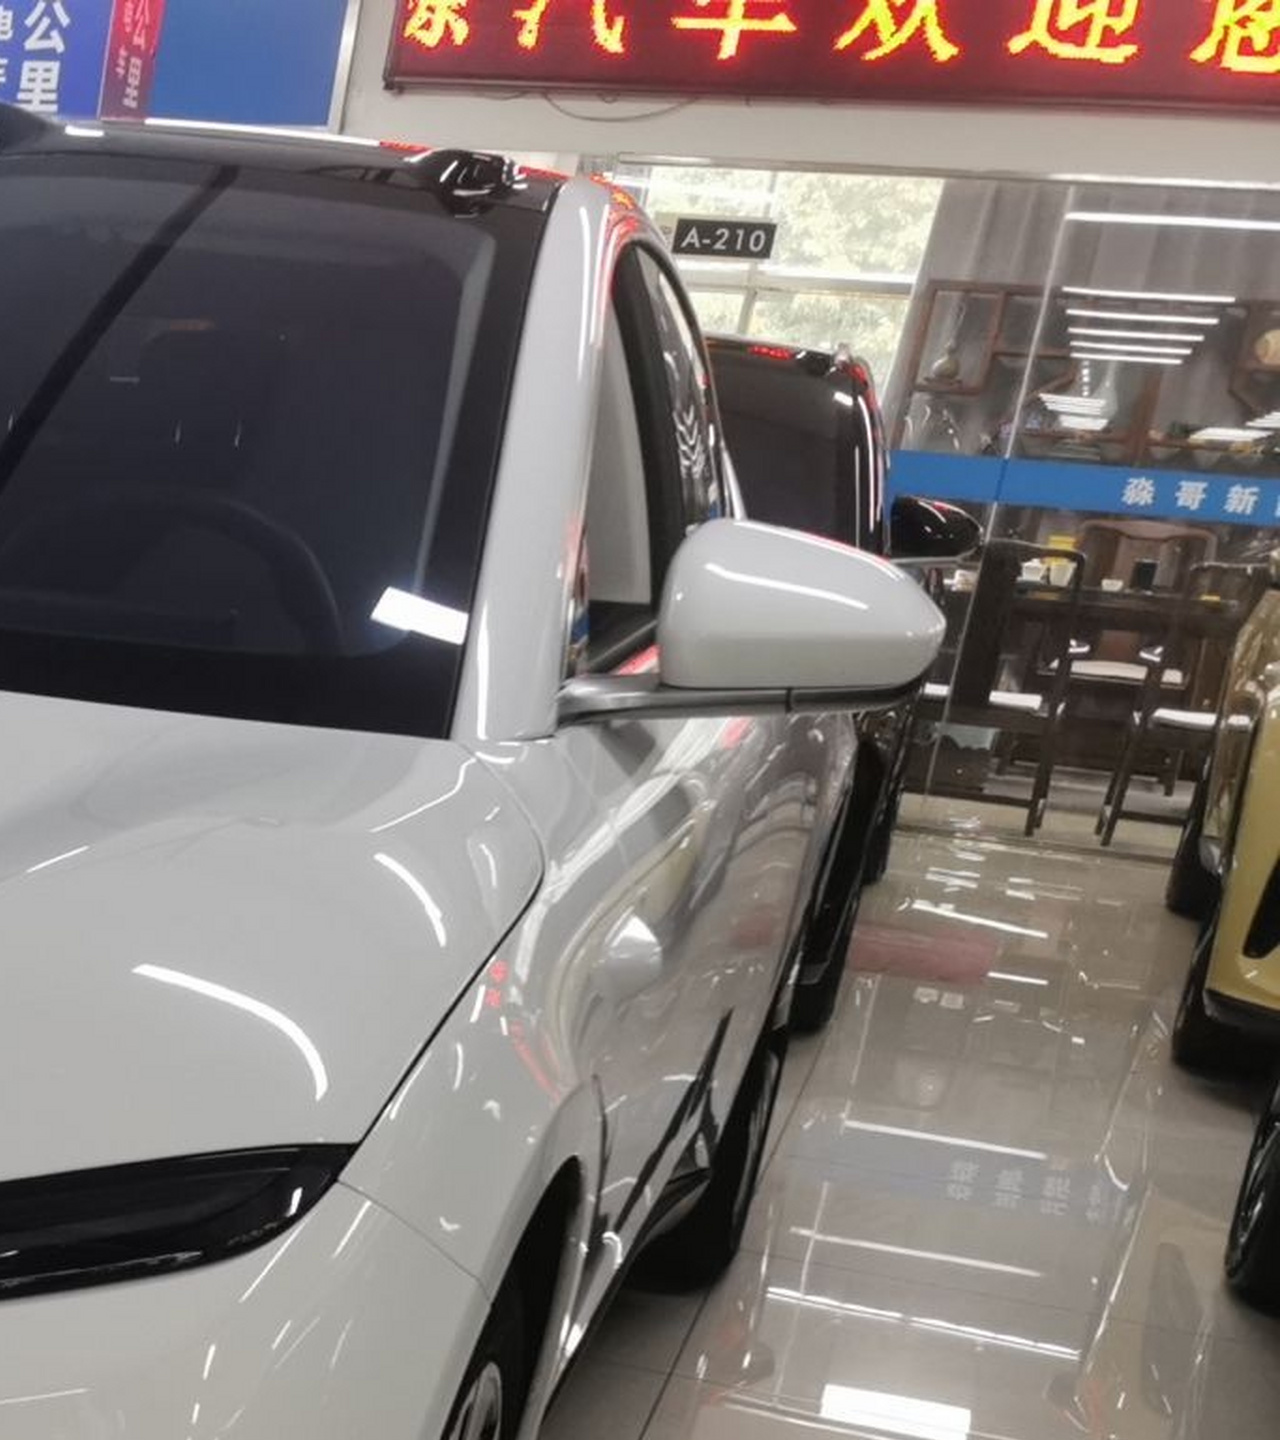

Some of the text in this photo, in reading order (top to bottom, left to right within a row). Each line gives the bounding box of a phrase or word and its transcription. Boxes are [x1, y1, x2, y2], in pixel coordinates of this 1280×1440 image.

[680, 226, 766, 252] A-210
[1121, 477, 1280, 517] 淼哥新
